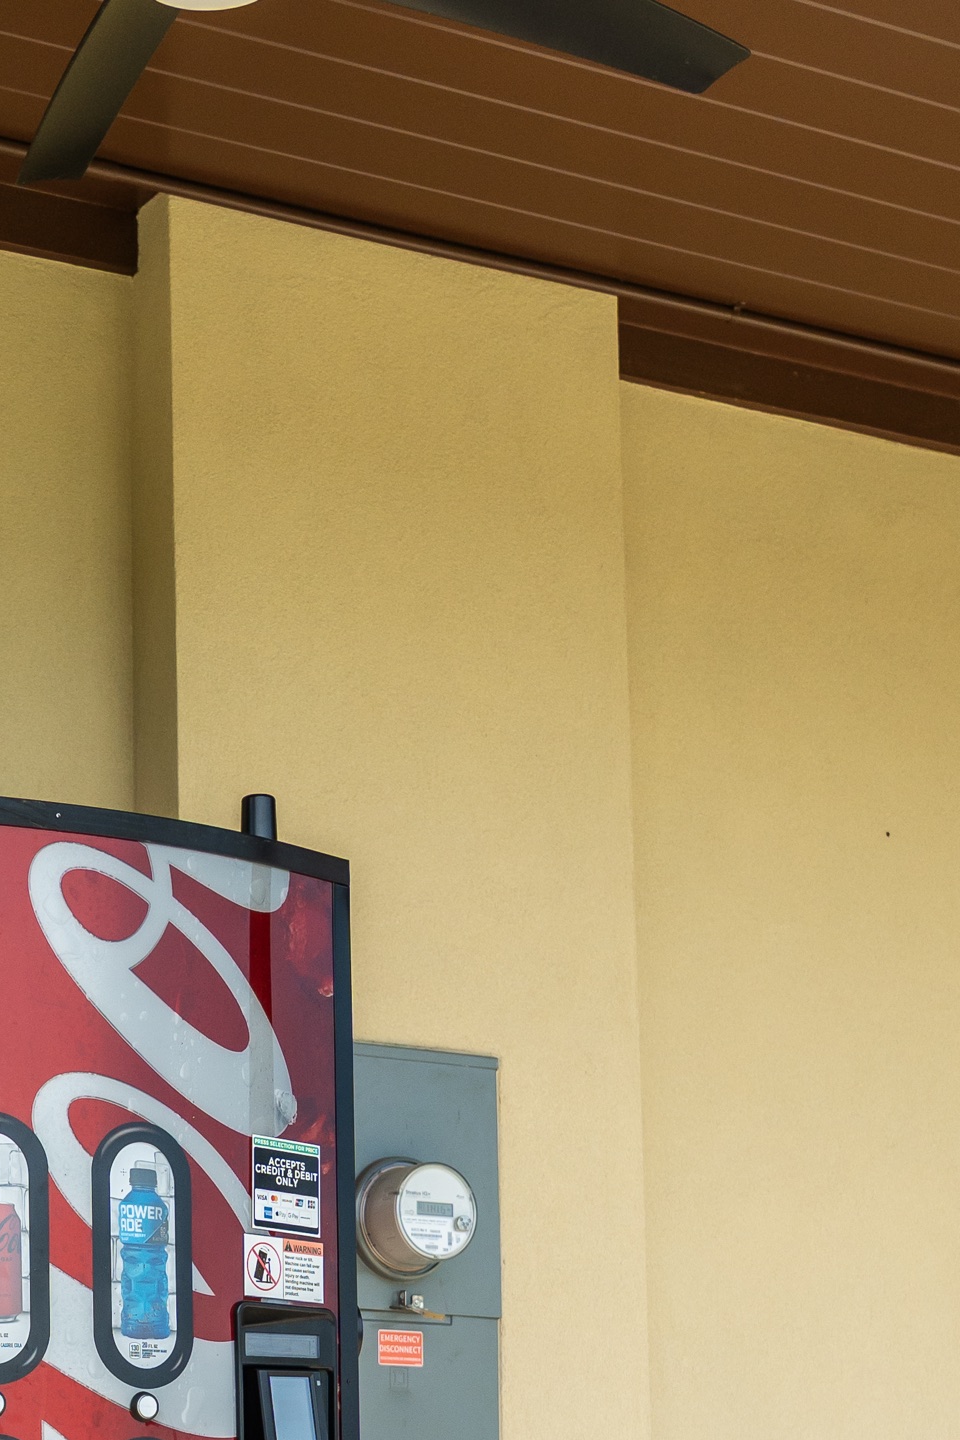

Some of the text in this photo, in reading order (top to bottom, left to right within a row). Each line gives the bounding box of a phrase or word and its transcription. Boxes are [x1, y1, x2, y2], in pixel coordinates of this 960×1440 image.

[270, 1141, 295, 1150] SELECTION
[268, 1157, 305, 1171] ACCEPTS
[255, 1164, 318, 1182] CREDIT & DEBIT
[276, 1176, 299, 1188] ONLY
[121, 1205, 162, 1220] POWER
[121, 1218, 142, 1232] ADE
[293, 1245, 321, 1255] WARNING
[380, 1334, 420, 1343] EMERGENCY
[380, 1345, 421, 1354] DISCONNECT
